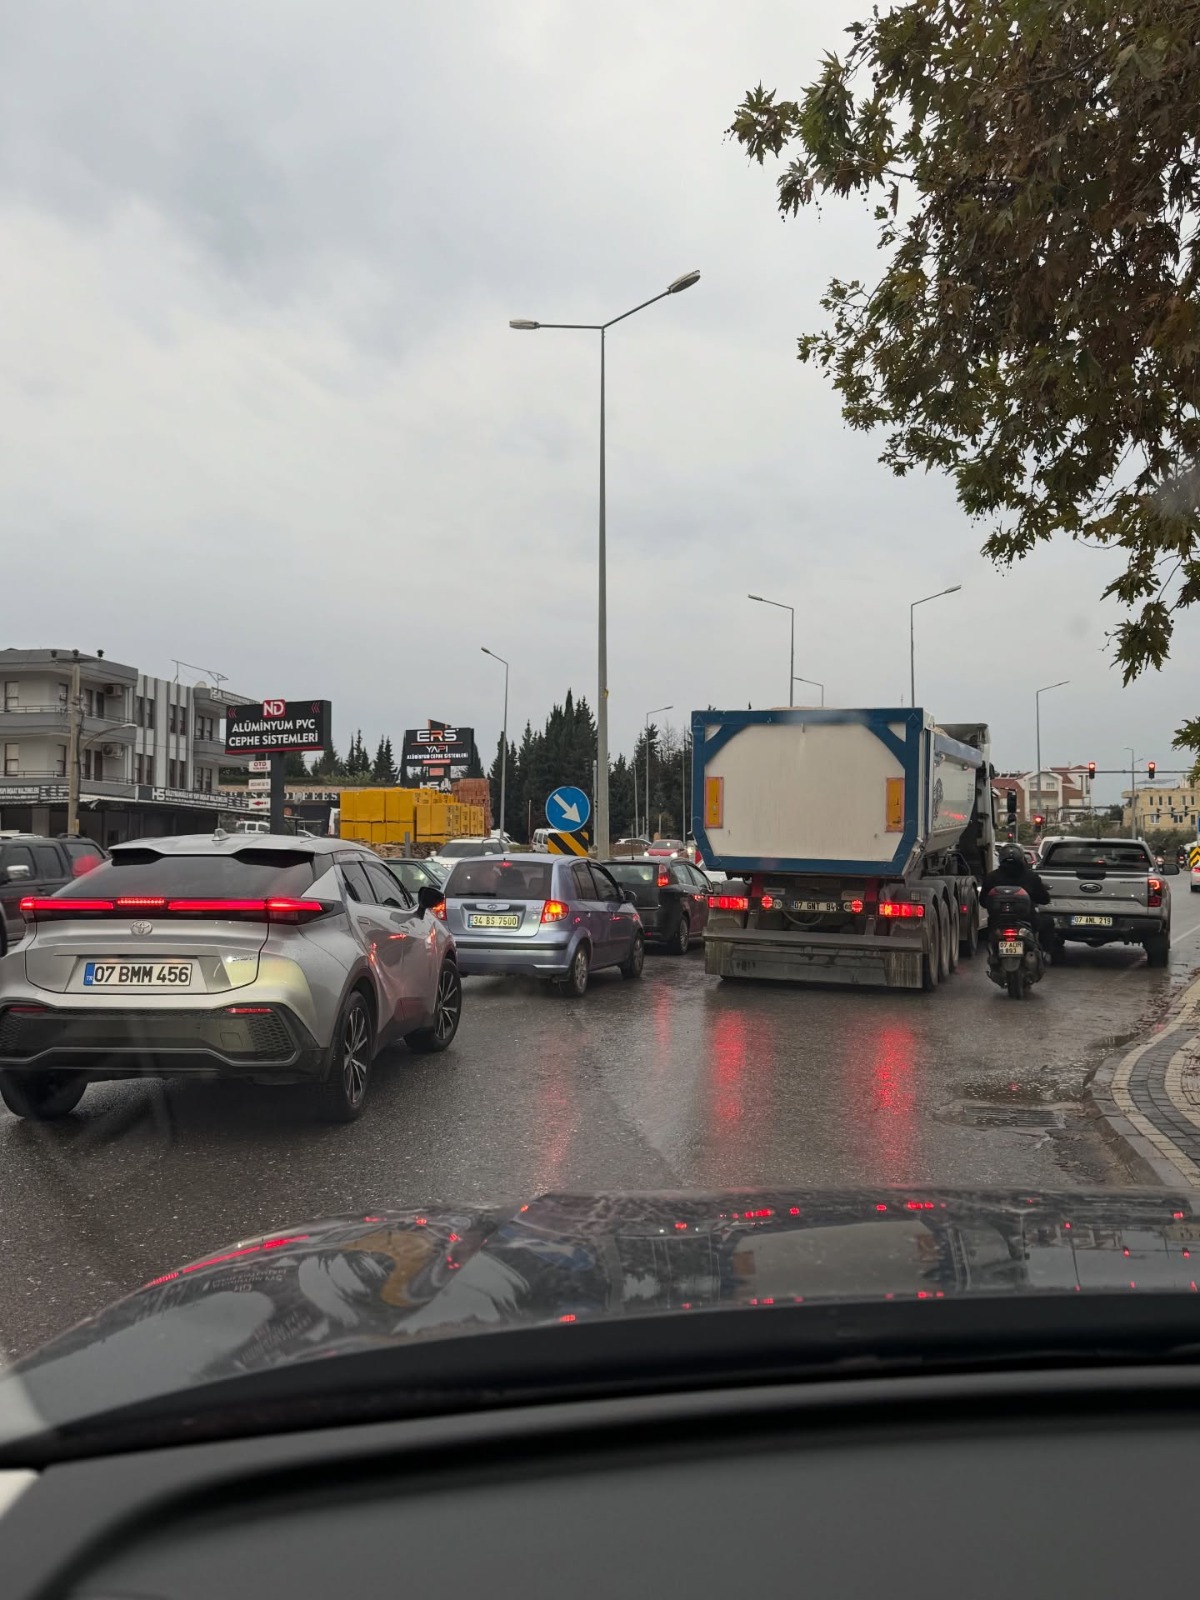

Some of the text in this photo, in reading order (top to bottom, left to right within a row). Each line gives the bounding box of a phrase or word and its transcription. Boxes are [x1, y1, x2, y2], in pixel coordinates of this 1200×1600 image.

[263, 701, 284, 716] ND
[232, 719, 315, 732] ALÜMİNYUM PVC
[229, 730, 318, 747] CEPHE SİSTEMLERİ
[417, 729, 457, 742] ERS
[426, 745, 449, 753] YAPI
[794, 901, 803, 910] 07
[473, 916, 482, 925] 34
[94, 966, 190, 983] 07 BMM 456
